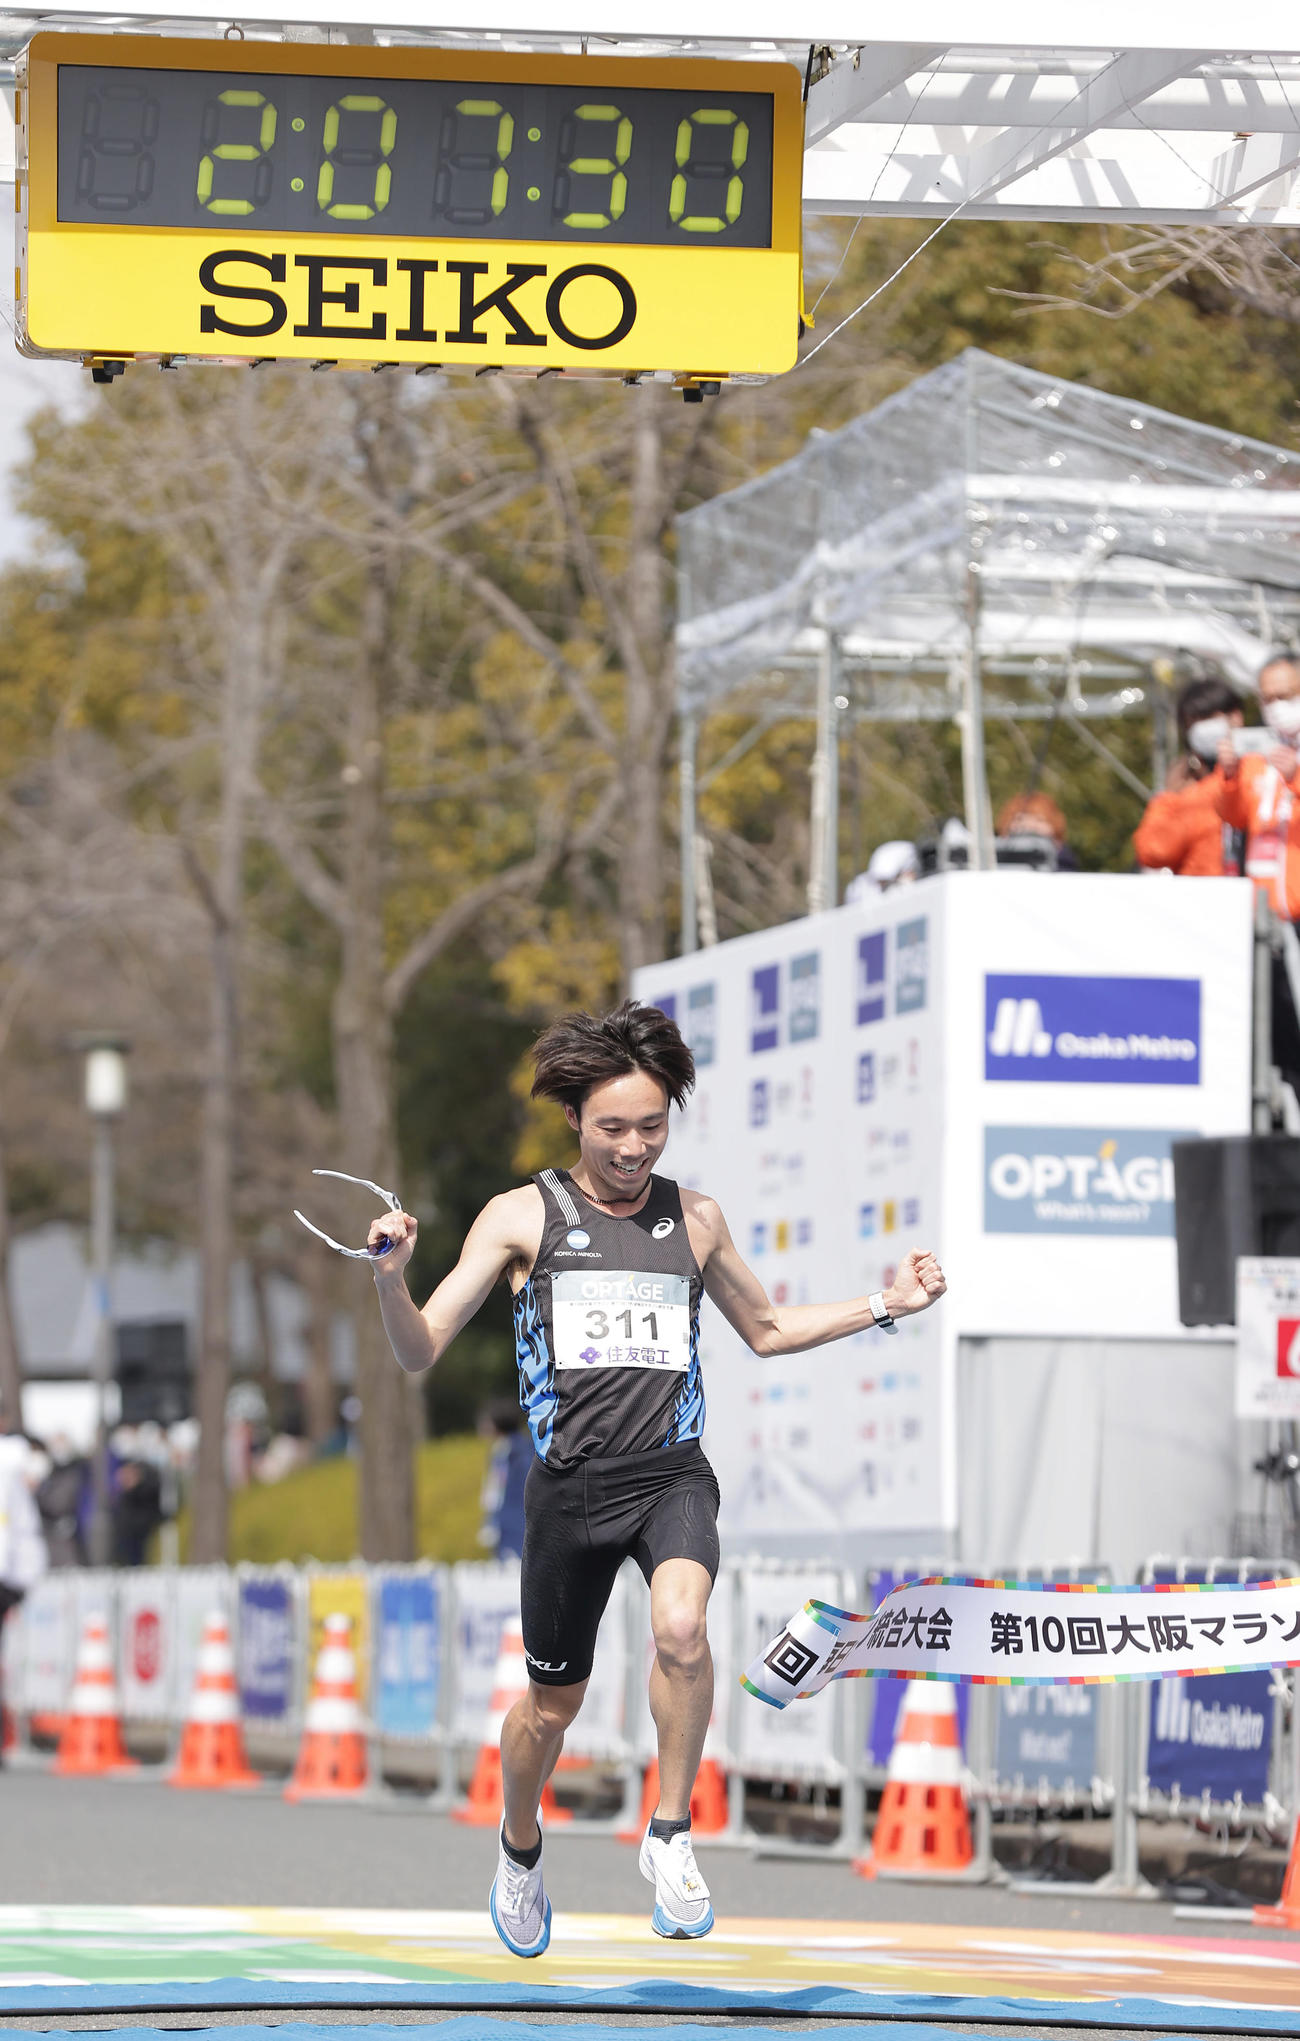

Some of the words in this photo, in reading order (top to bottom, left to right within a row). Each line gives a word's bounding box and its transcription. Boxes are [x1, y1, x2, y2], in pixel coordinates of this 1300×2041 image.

[197, 89, 750, 233] 2:07:30
[199, 249, 638, 351] SEIKO
[1054, 1031, 1129, 1060] Osaka
[1127, 1034, 1197, 1062] Metro
[580, 1275, 665, 1301] OPTAGE
[585, 1309, 659, 1341] 311
[606, 1346, 671, 1365] 住友電工
